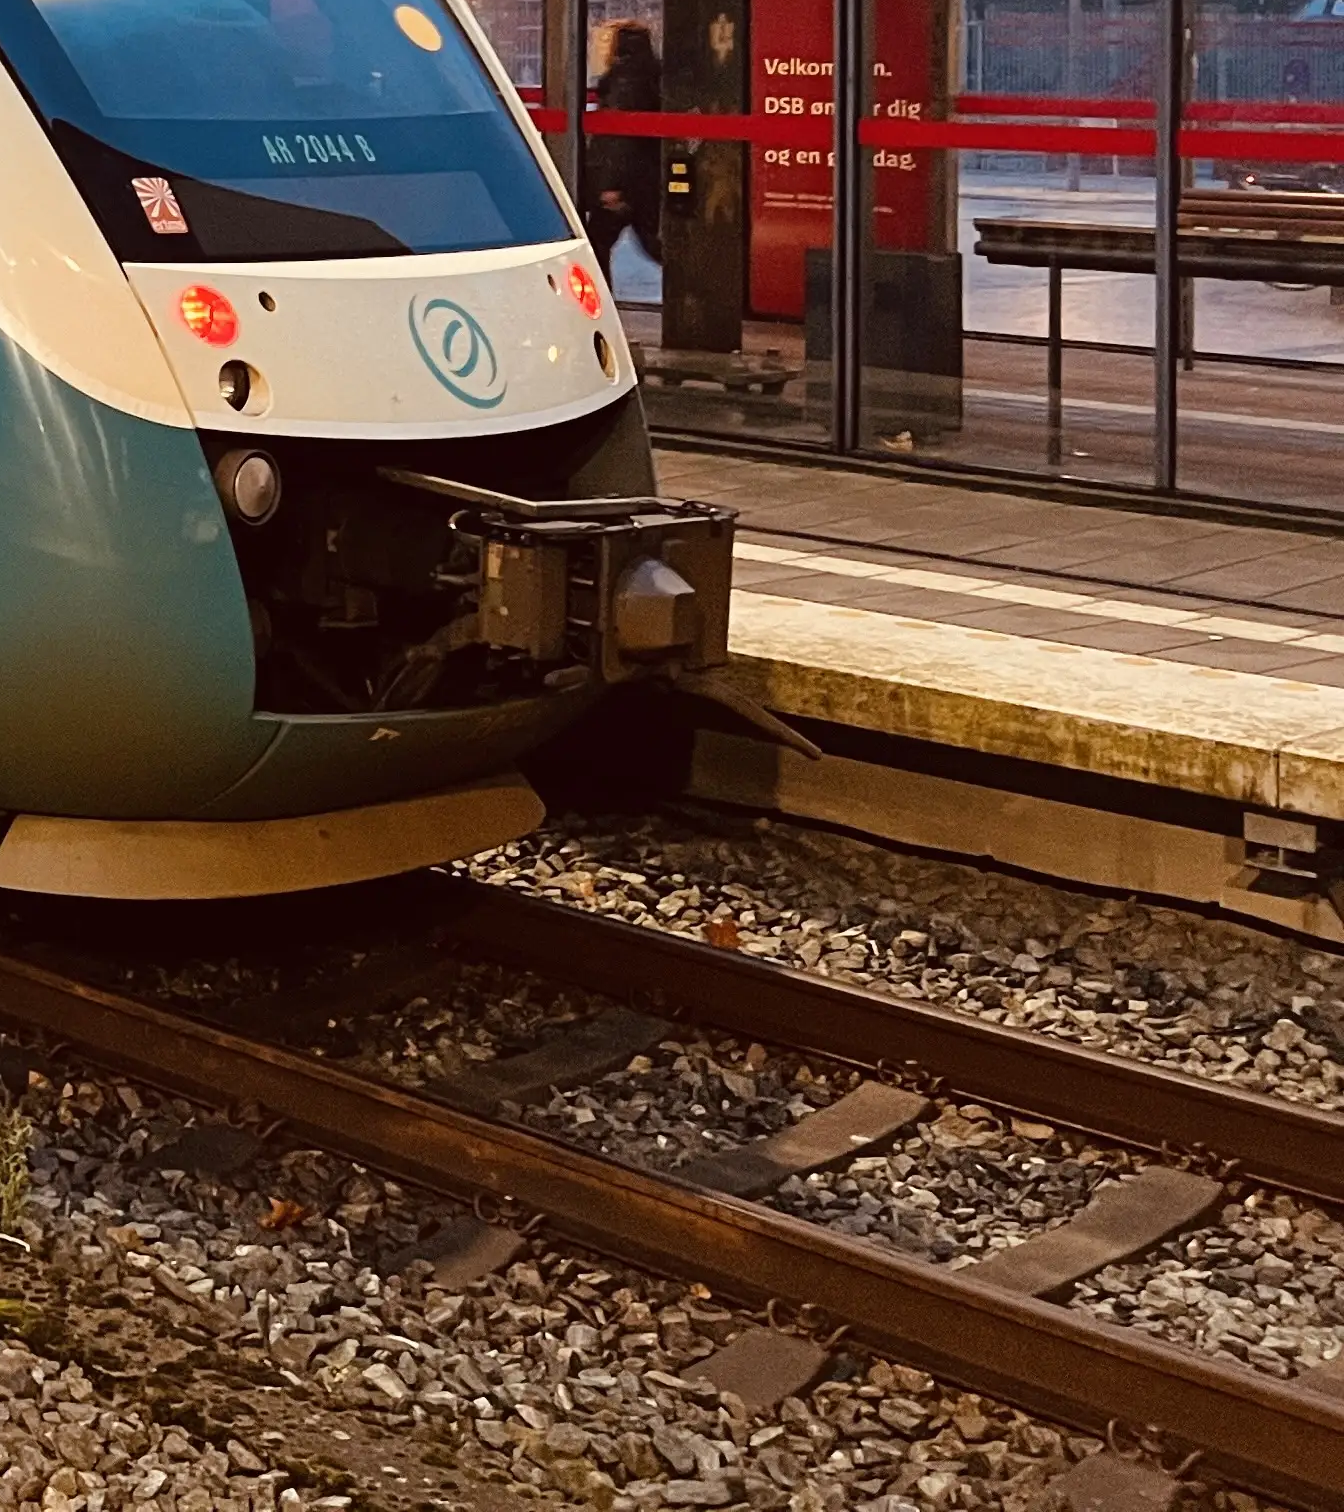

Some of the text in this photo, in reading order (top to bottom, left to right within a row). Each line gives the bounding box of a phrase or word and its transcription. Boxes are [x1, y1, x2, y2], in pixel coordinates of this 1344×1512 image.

[765, 96, 805, 115] DSB
[887, 98, 922, 121] dig
[262, 134, 377, 164] AR 2044 B
[764, 149, 790, 167] og
[796, 150, 821, 165] en
